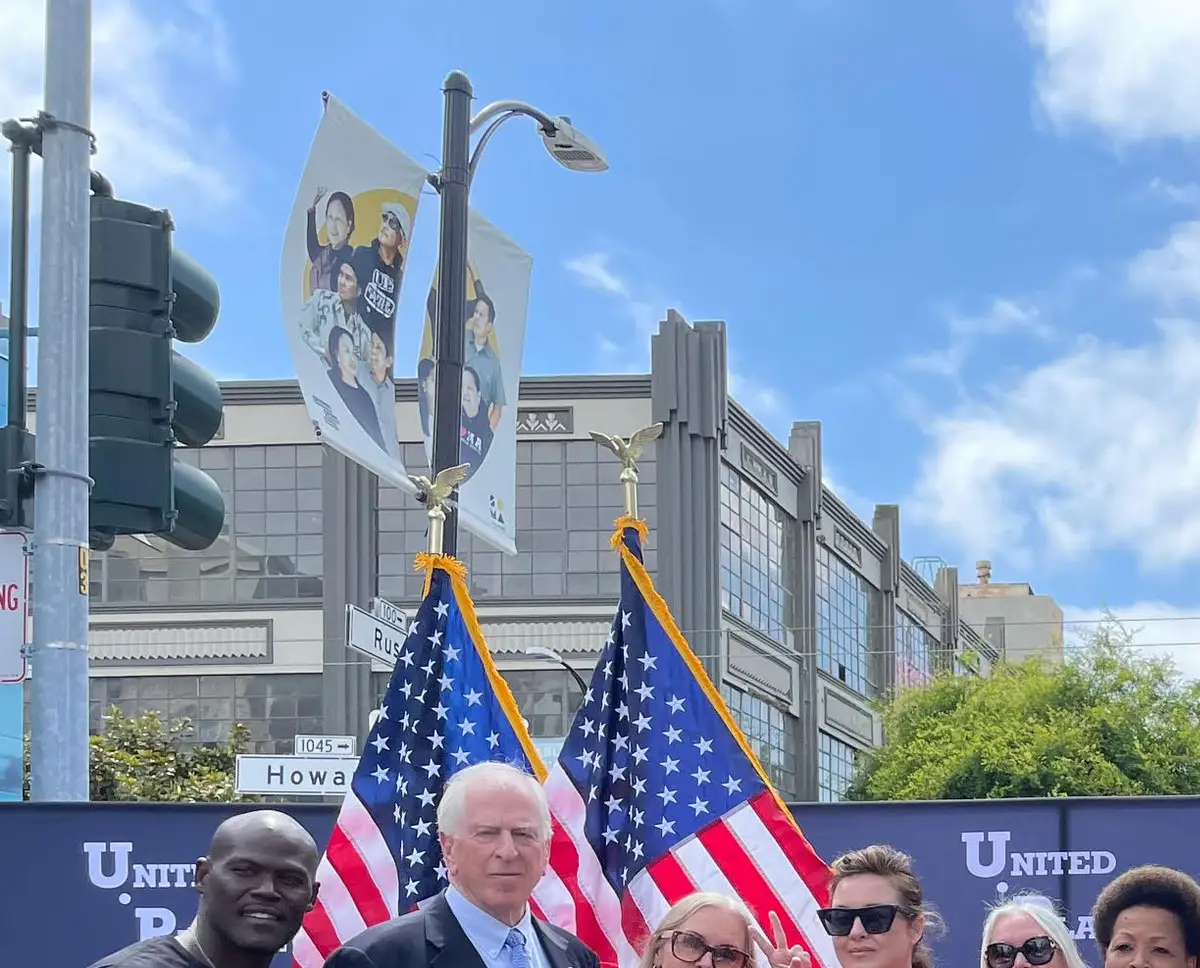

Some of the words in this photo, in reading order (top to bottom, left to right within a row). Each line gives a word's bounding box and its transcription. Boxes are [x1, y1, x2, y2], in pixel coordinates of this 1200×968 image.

[383, 604, 397, 623] 100
[374, 628, 400, 658] Rus
[301, 738, 333, 753] 1045
[267, 765, 346, 785] Howa
[83, 842, 197, 889] UNIT
[961, 831, 1117, 878] UNITED
